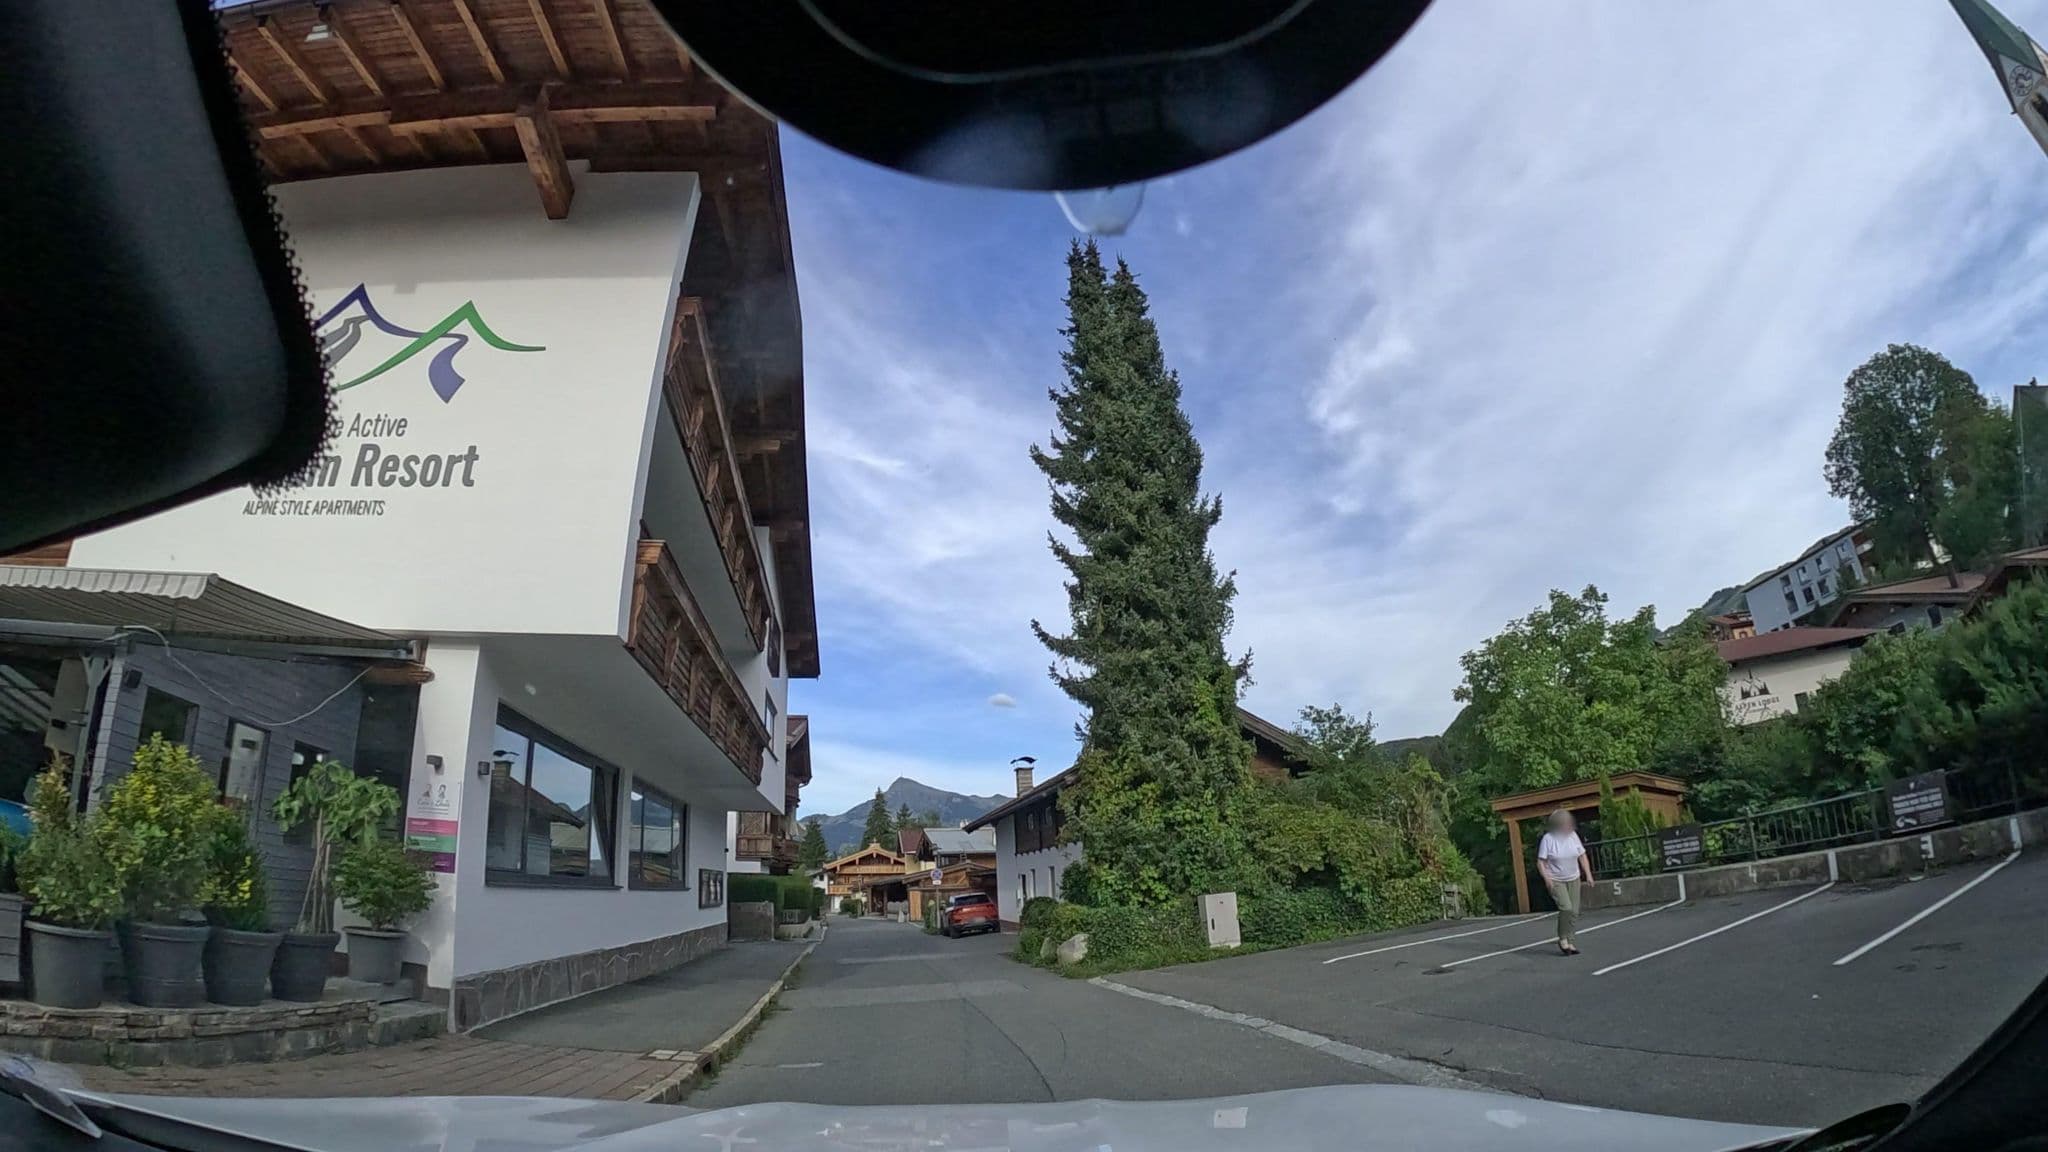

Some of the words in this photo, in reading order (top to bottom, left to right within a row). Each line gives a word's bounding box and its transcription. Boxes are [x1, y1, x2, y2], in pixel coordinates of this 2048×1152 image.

[347, 413, 408, 437] Active
[350, 443, 479, 488] Resort
[243, 499, 278, 516] ALPINE
[279, 499, 309, 516] STYLE
[311, 499, 386, 516] APARTMENTS
[1613, 882, 1622, 895] 5
